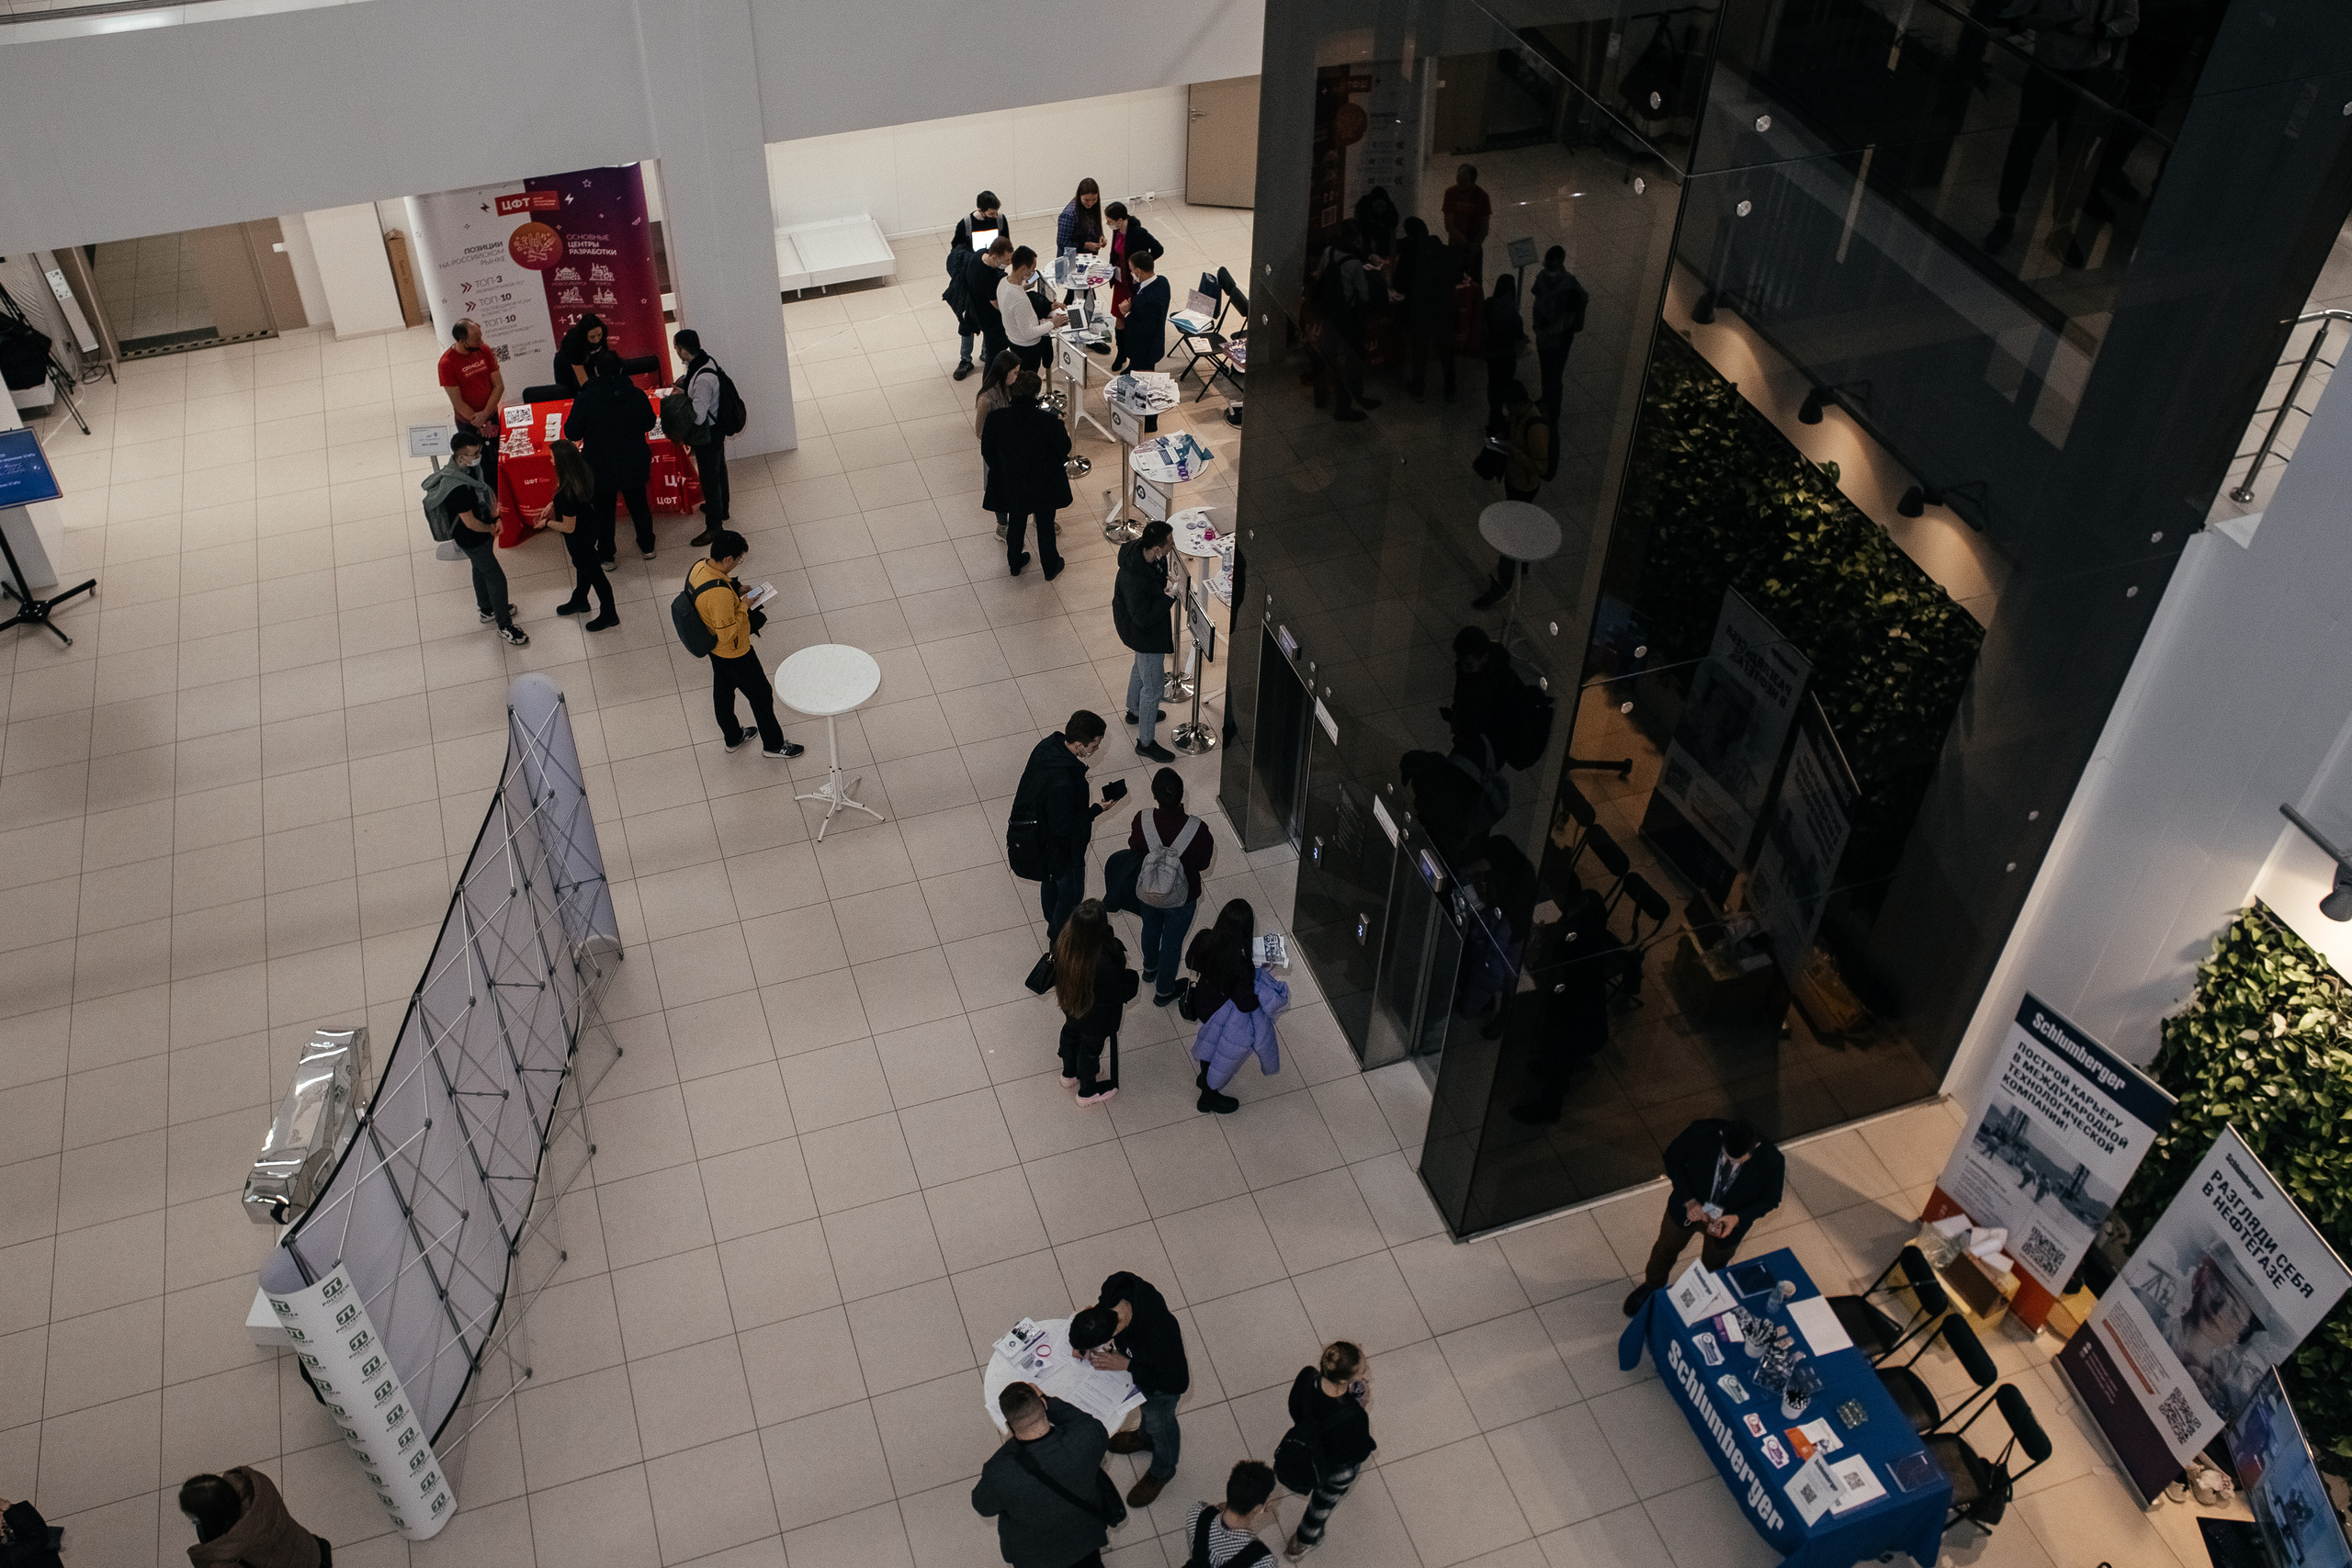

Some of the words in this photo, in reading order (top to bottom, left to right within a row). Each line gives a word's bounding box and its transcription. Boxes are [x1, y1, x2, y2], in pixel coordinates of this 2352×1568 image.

[502, 197, 530, 210] ЦФТ
[464, 241, 503, 254] ПОЗИЦИИ
[462, 359, 485, 372] ORACLE
[656, 496, 677, 504] ЦФТ
[2032, 1012, 2126, 1090] Schlumberger
[2018, 1042, 2070, 1086] ПОСТРОЙ
[2071, 1084, 2124, 1129] КАРЬЕРУ
[2002, 1074, 2069, 1132] КОМПАНИИ!
[2008, 1063, 2115, 1155] ТЕХНОЛОГИЧЕСКОЙ
[2013, 1053, 2020, 1063] В
[2022, 1061, 2129, 1149] МЕЖДУНАРОДНОЙ
[2202, 1182, 2214, 1197] В
[2212, 1195, 2286, 1290] НЕФТЕГАЗЕ
[2211, 1169, 2278, 1255] РАЗГЛЯДИ
[2276, 1253, 2314, 1299] СЕБЯ
[322, 1283, 349, 1306] POLYTECH
[335, 1310, 362, 1334] POLYTECH
[349, 1336, 375, 1359] POLYTECH
[362, 1361, 387, 1384] POLYTECH
[374, 1385, 399, 1409] POLYTECH
[386, 1409, 410, 1432] POLYTECH
[1668, 1339, 1784, 1531] Schlumberger
